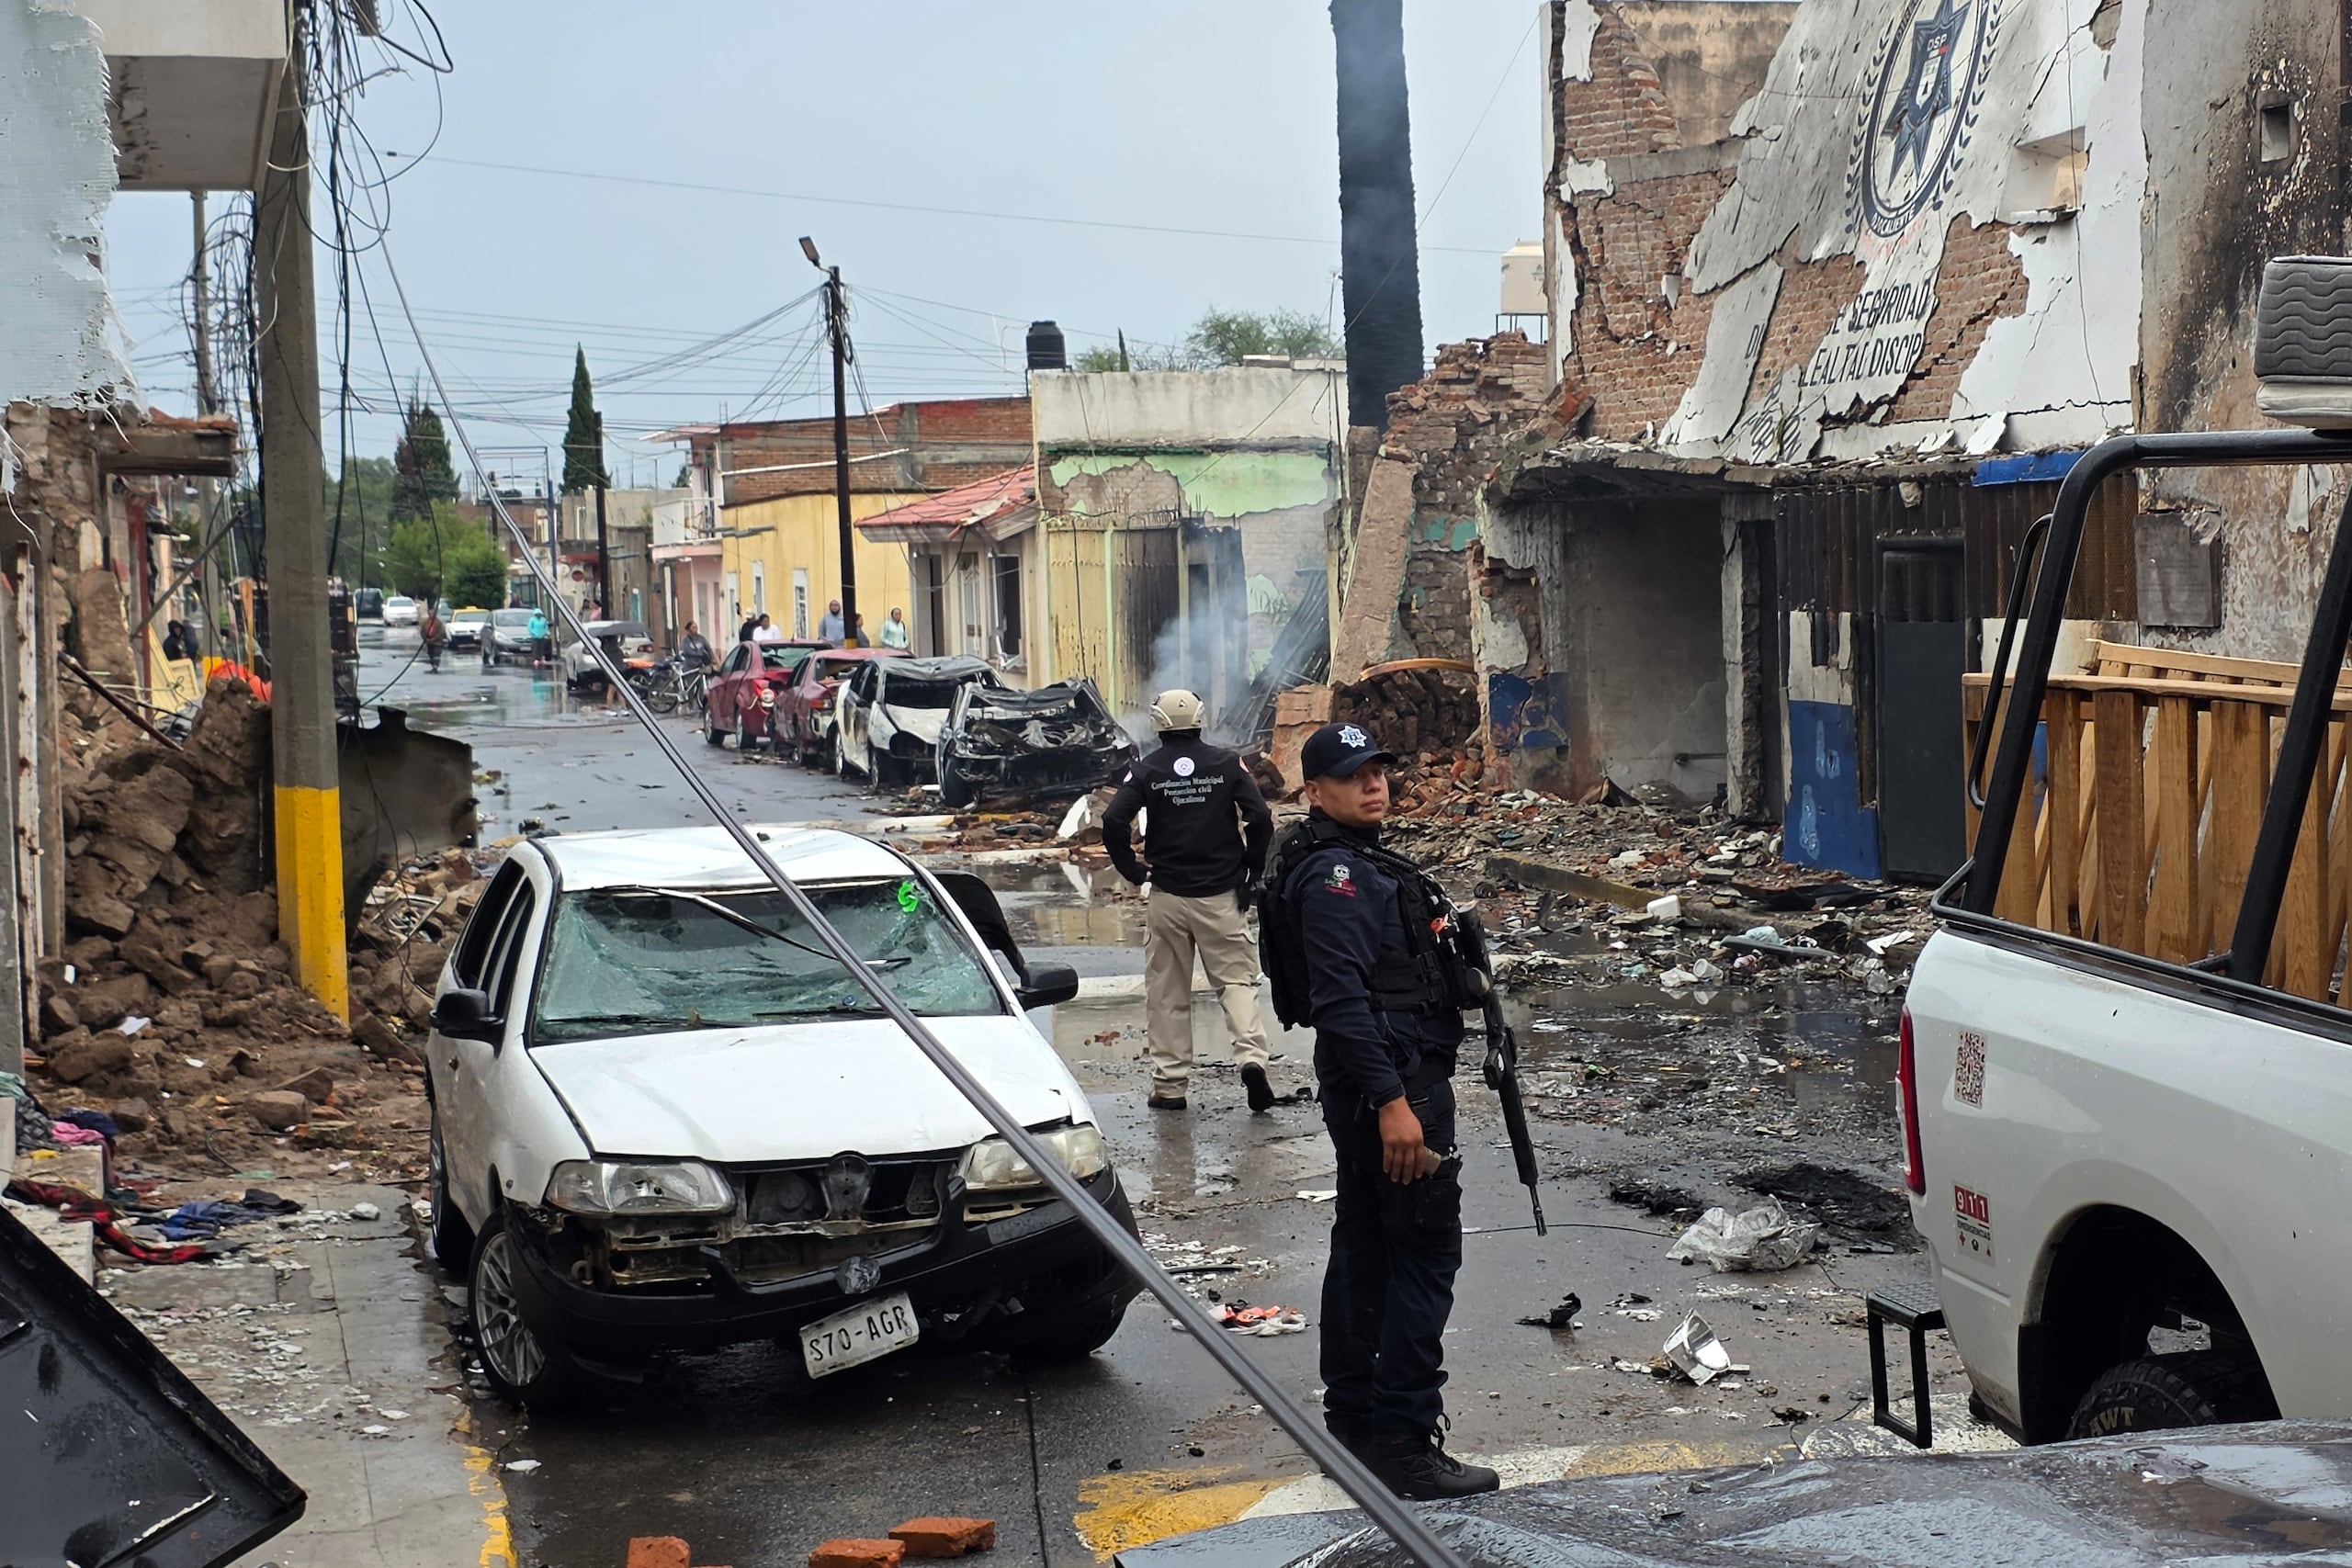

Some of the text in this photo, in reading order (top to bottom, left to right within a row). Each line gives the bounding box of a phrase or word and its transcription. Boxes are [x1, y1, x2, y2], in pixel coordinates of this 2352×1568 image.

[1927, 33, 1947, 52] DSP
[1957, 1191, 1985, 1218] 911
[809, 1305, 908, 1361] S70-AGR
